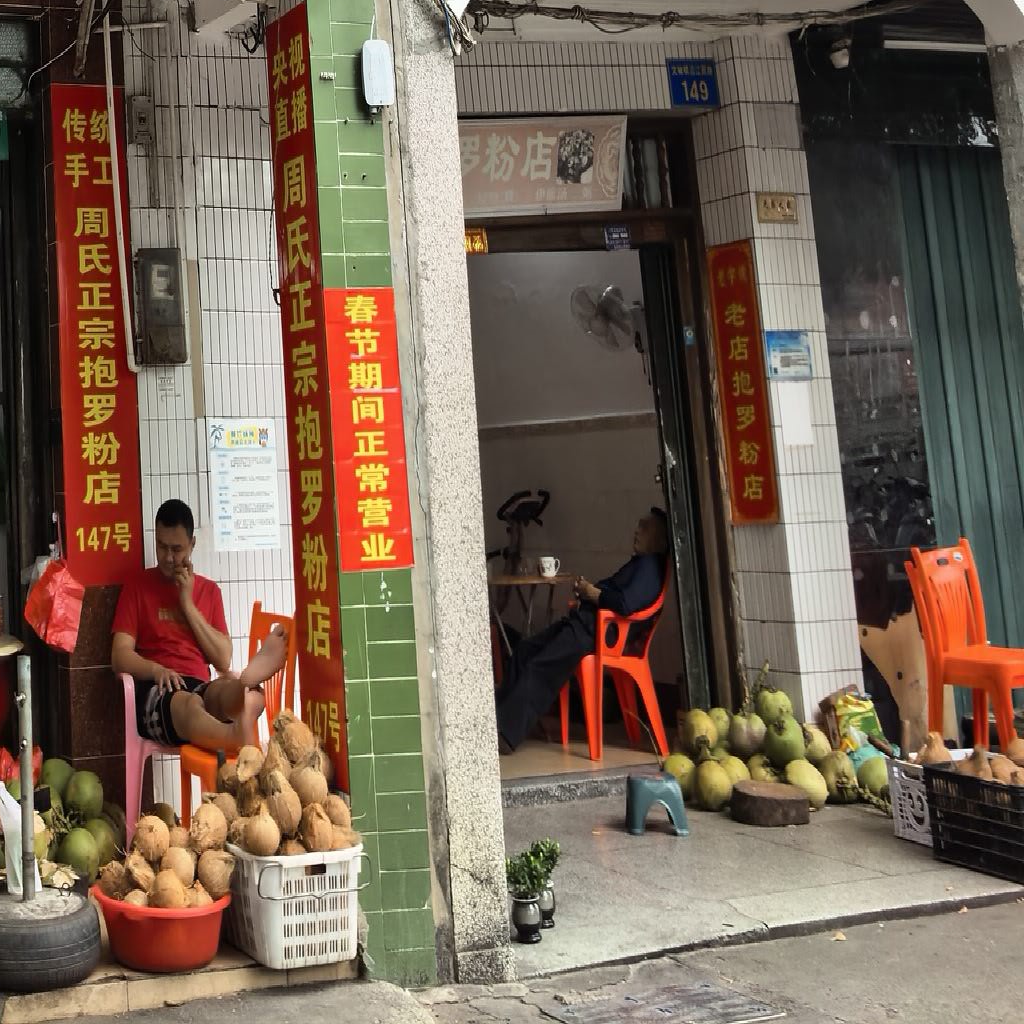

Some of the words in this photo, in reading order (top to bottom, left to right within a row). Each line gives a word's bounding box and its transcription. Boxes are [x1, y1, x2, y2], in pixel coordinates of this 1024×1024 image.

[272, 32, 306, 91] 央视
[275, 90, 308, 142] 直播
[681, 80, 709, 101] 149
[64, 152, 113, 188] 手工
[74, 207, 122, 506] 周氏正宗抱罗粉店
[282, 155, 332, 661] 周氏正宗抱罗粉店
[344, 295, 396, 563] 春节期间正常营业
[724, 302, 764, 502] 老店抱罗粉店
[75, 522, 132, 553] 147号
[307, 700, 340, 753] 147号
